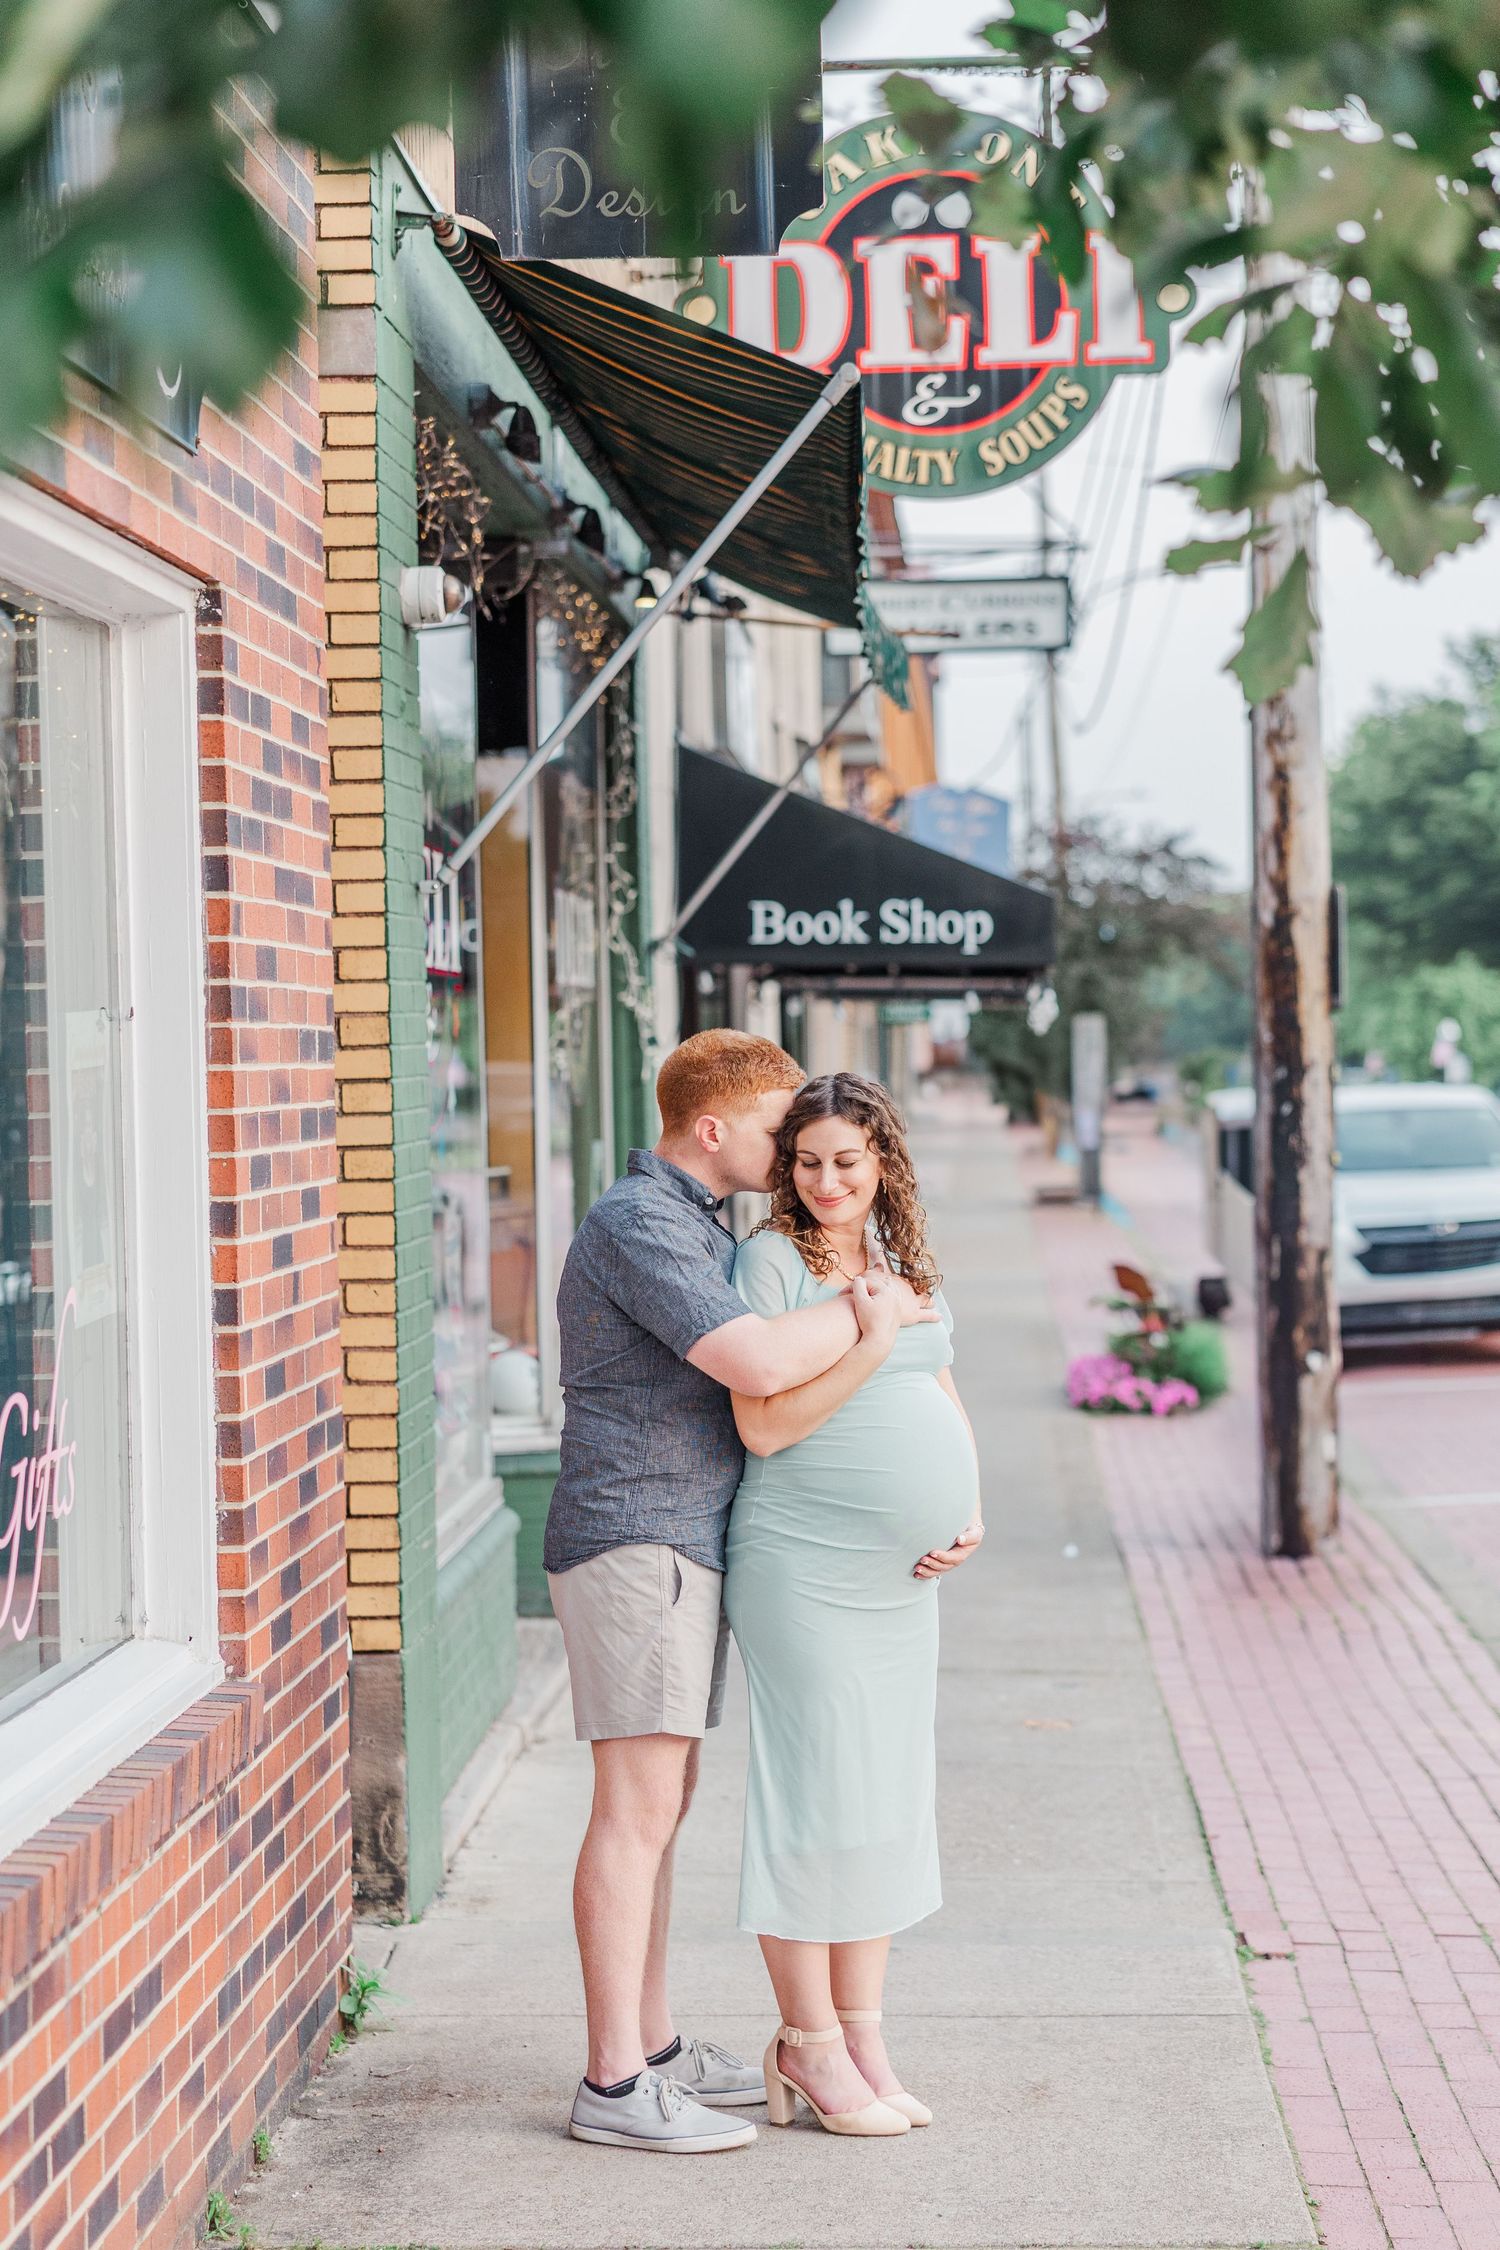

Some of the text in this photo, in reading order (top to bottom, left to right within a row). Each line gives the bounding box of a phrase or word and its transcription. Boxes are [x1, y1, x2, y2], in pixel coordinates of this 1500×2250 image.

[720, 231, 1155, 373] DELI
[902, 372, 982, 426] &
[978, 374, 1090, 478] SOUPS
[748, 897, 995, 957] Book Shop
[0, 1287, 78, 1642] Gifts
